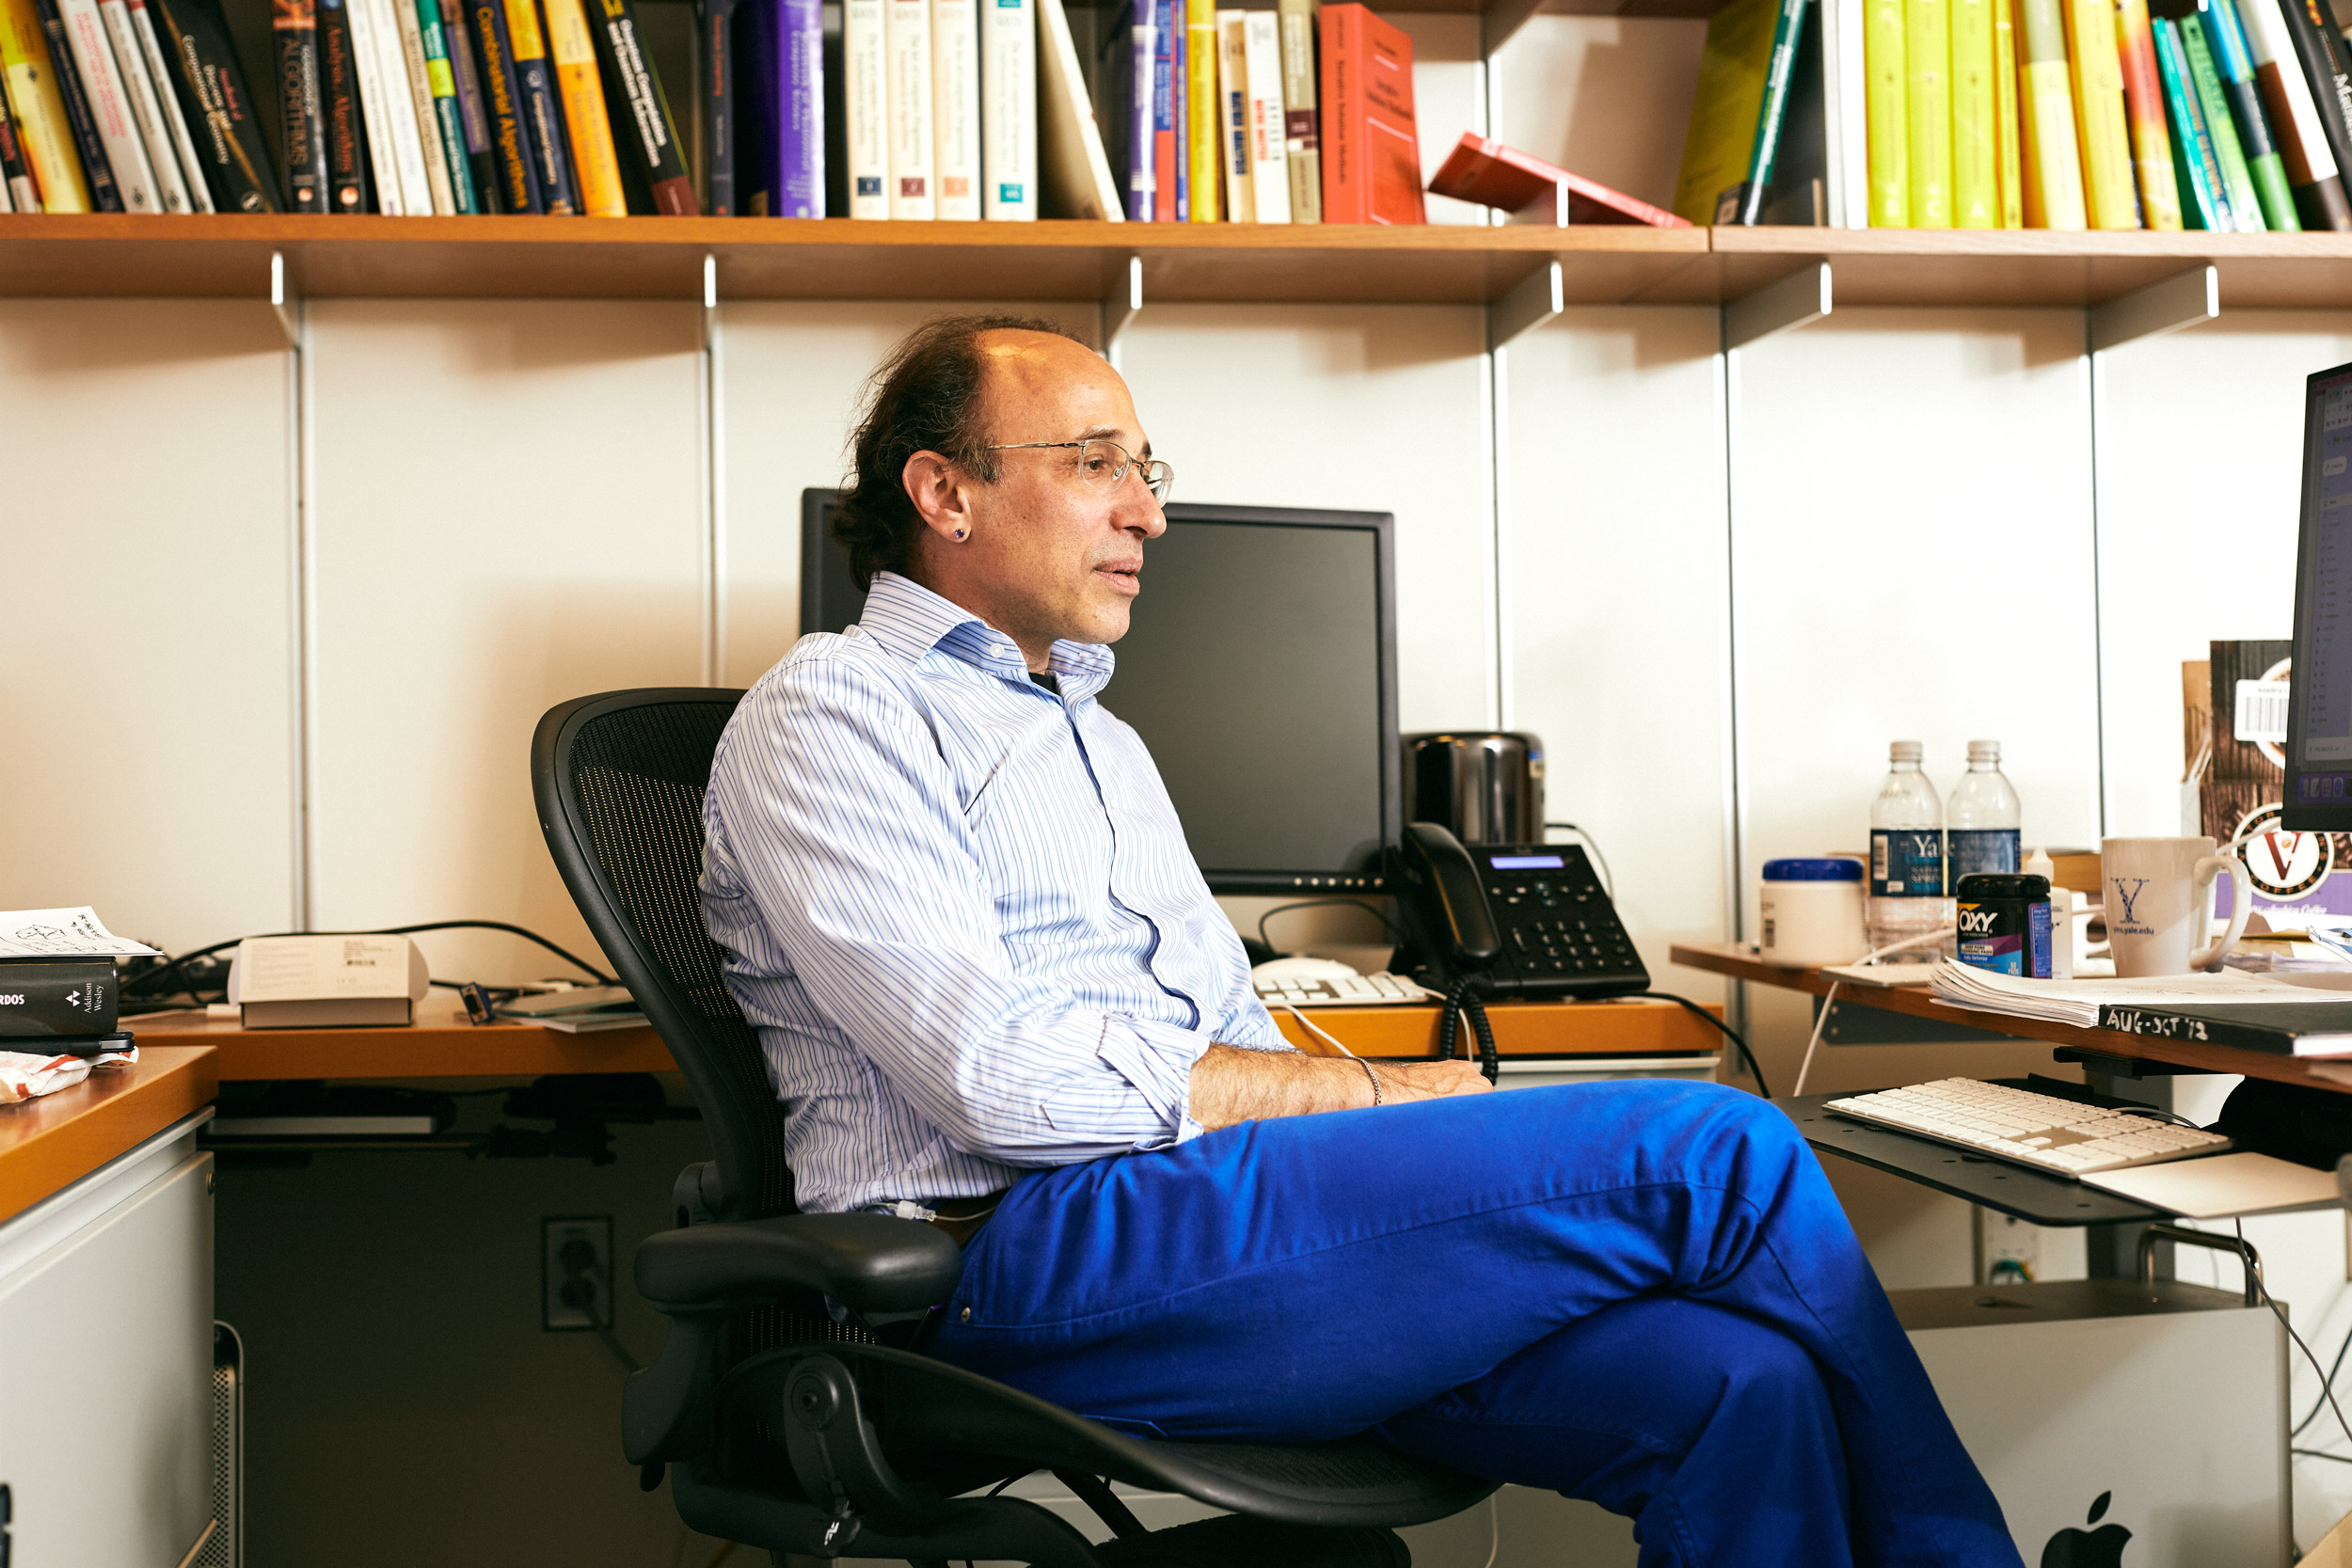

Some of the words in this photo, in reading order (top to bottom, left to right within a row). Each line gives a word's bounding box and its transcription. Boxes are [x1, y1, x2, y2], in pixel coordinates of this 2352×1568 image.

[607, 22, 624, 46] and
[614, 44, 640, 100] Quantum
[619, 20, 644, 73] Quantum
[636, 72, 667, 147] Computation
[183, 35, 215, 112] Computational
[206, 111, 230, 165] Geometry
[281, 38, 309, 166] ALGORITHMS
[476, 6, 513, 116] Combinatorial
[498, 117, 529, 210] Algorithms
[332, 95, 355, 173] Algorithms
[631, 98, 660, 167] Information
[1926, 199, 1942, 218] C
[1968, 200, 1986, 219] A
[2249, 874, 2319, 895] COFFEE
[1959, 911, 1999, 932] OXY
[84, 982, 92, 1013] Addison
[94, 985, 103, 1011] Wesley
